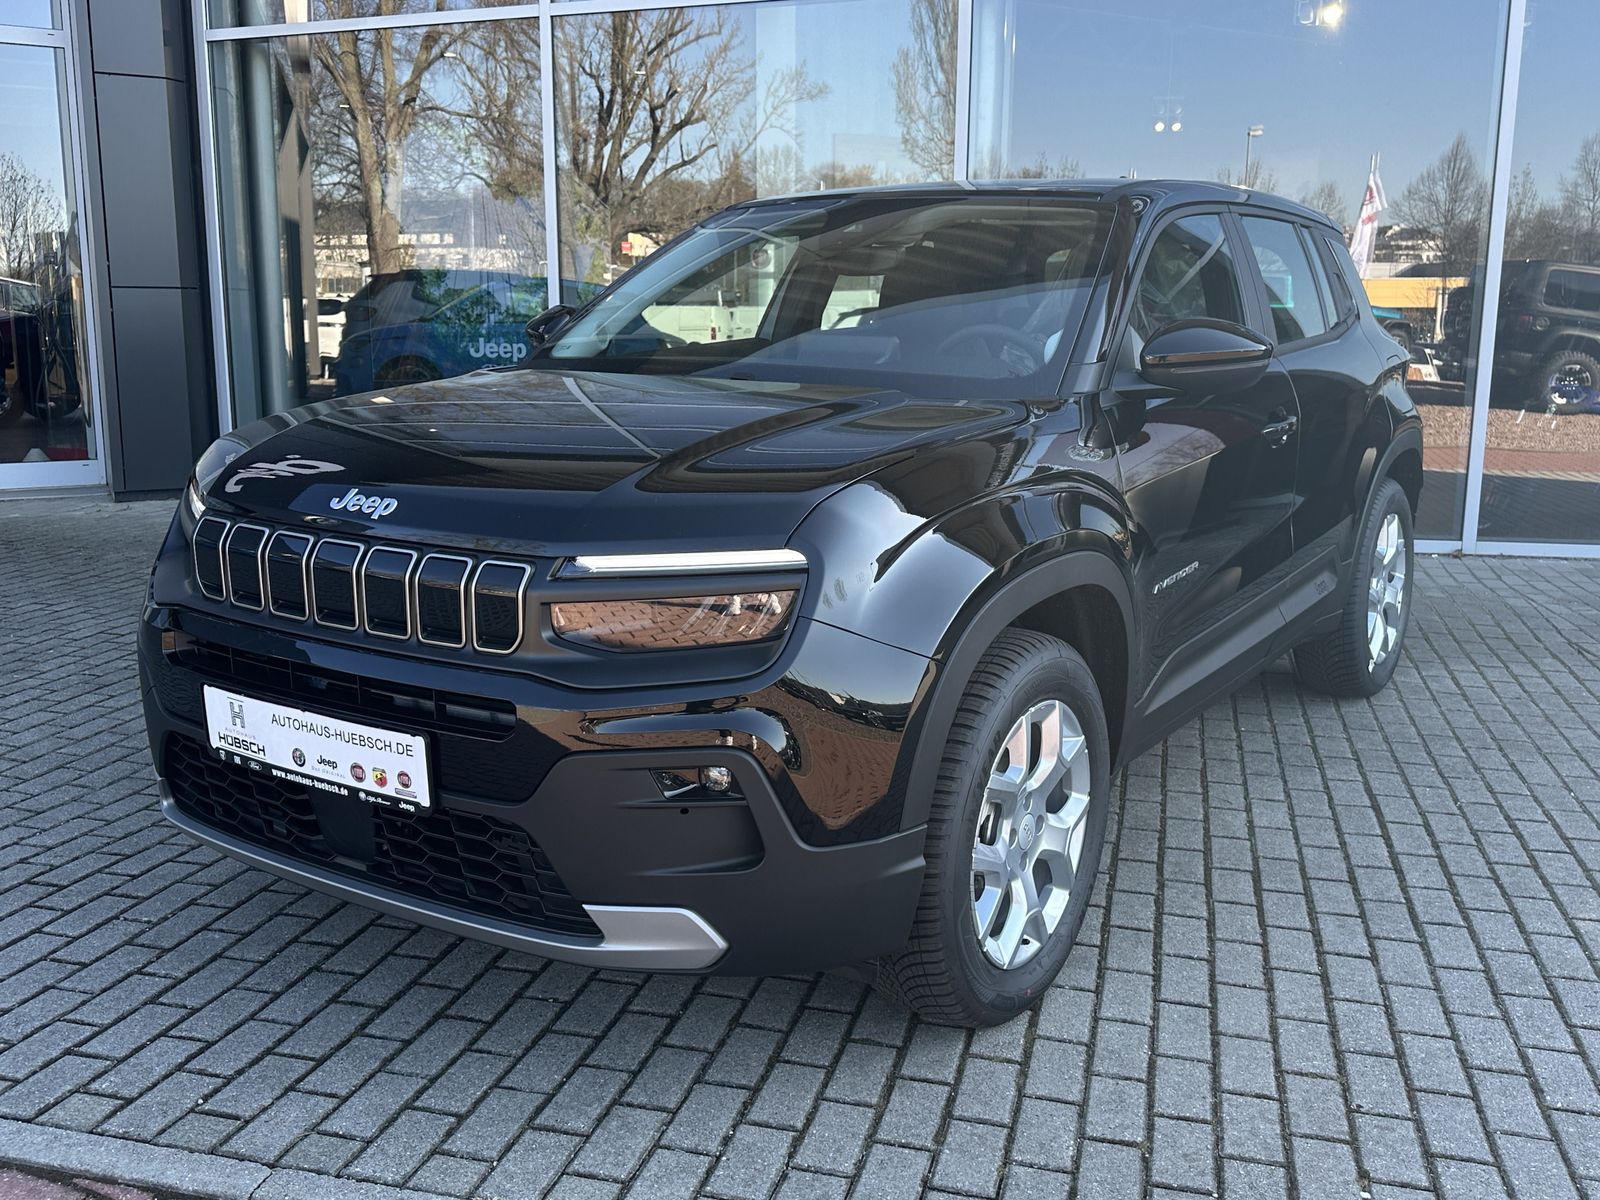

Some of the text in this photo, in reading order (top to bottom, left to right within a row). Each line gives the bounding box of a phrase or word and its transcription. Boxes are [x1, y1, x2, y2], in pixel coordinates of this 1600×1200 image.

[469, 338, 527, 362] Jeep
[330, 488, 398, 520] Jeep
[1152, 561, 1199, 594] AVENGER
[271, 713, 414, 757] AUTOHAUS-HUEBSCH.DE
[317, 755, 338, 770] Jeep
[271, 768, 349, 797] www.autohaus-huebsch.de
[398, 801, 416, 813] Jeep
